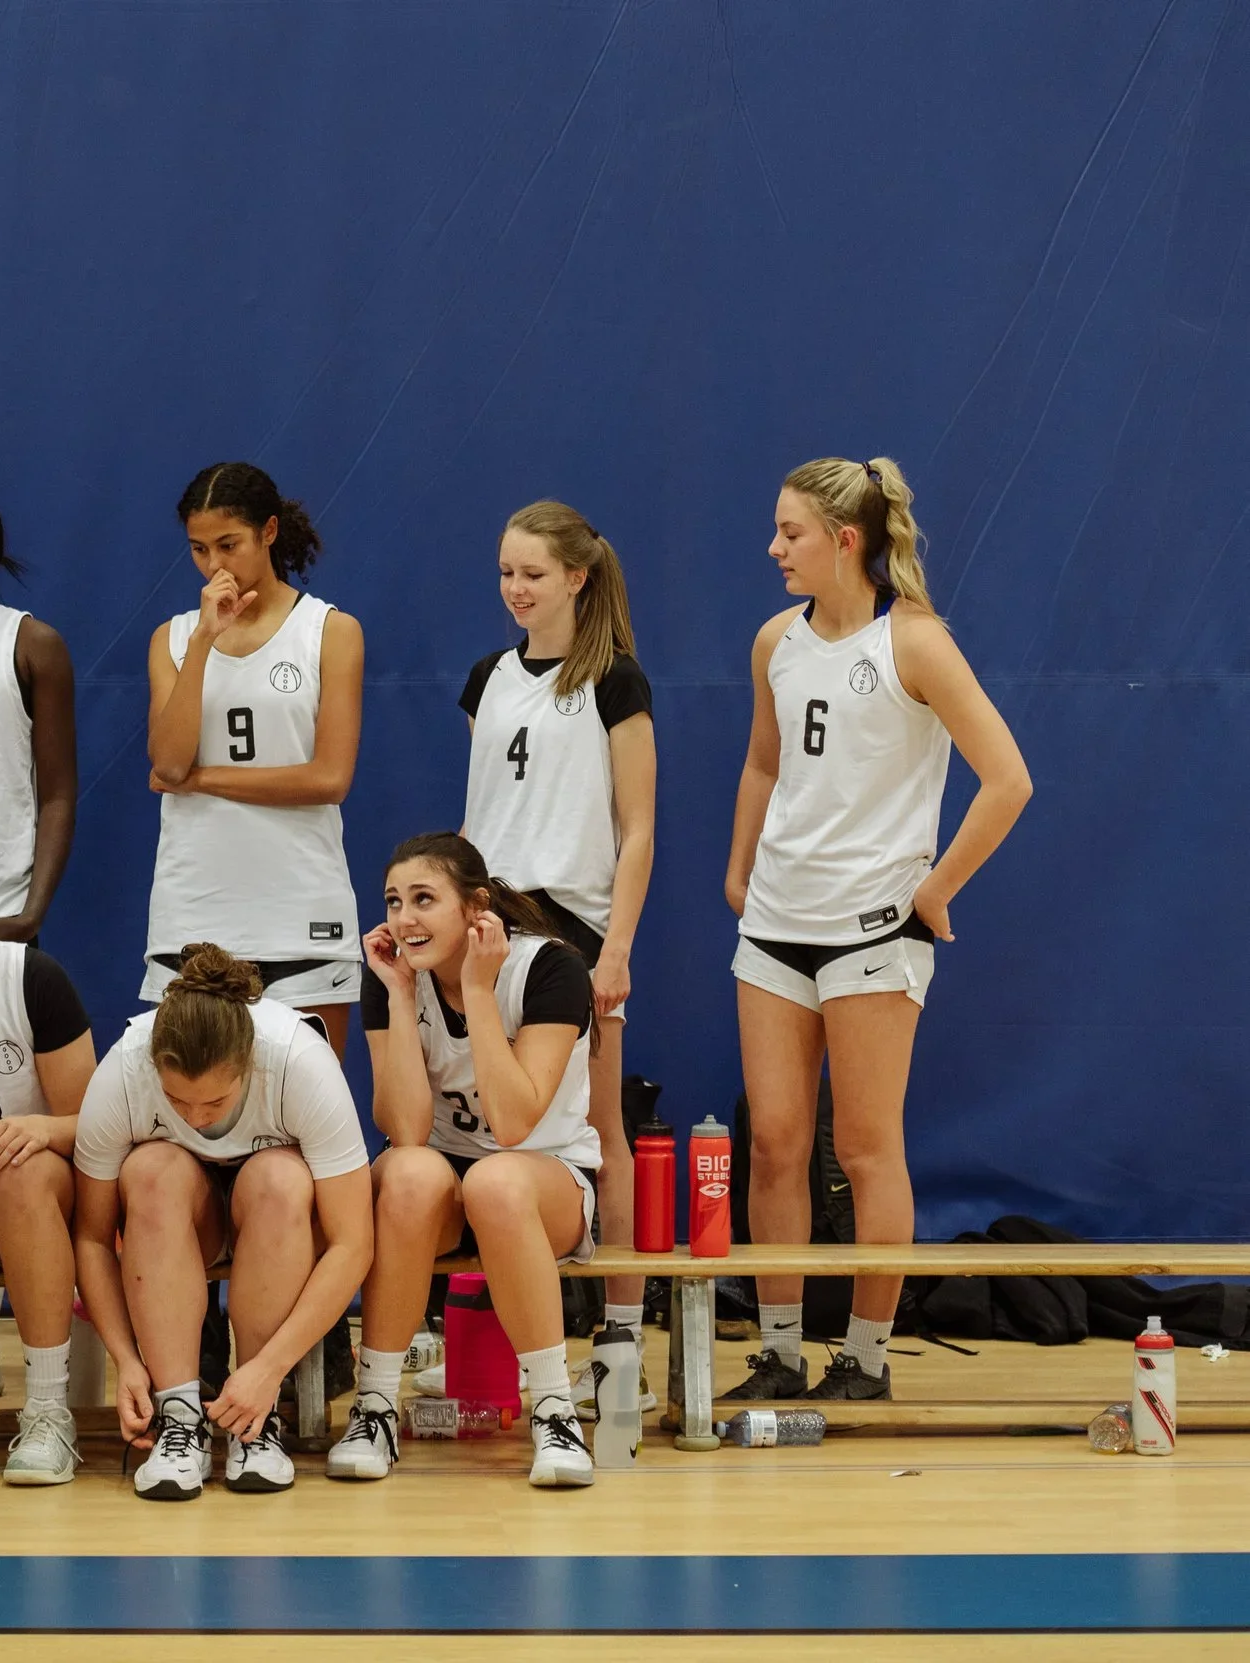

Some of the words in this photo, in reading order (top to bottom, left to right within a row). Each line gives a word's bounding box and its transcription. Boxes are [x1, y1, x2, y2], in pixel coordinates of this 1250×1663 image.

[227, 707, 256, 762] 9
[803, 699, 828, 757] 6
[507, 726, 529, 780] 4
[885, 910, 895, 920] M
[333, 927, 340, 935] M
[441, 1089, 492, 1133] 3
[696, 1154, 731, 1172] BIO
[697, 1172, 730, 1181] STEEL
[408, 1345, 419, 1369] ZERO
